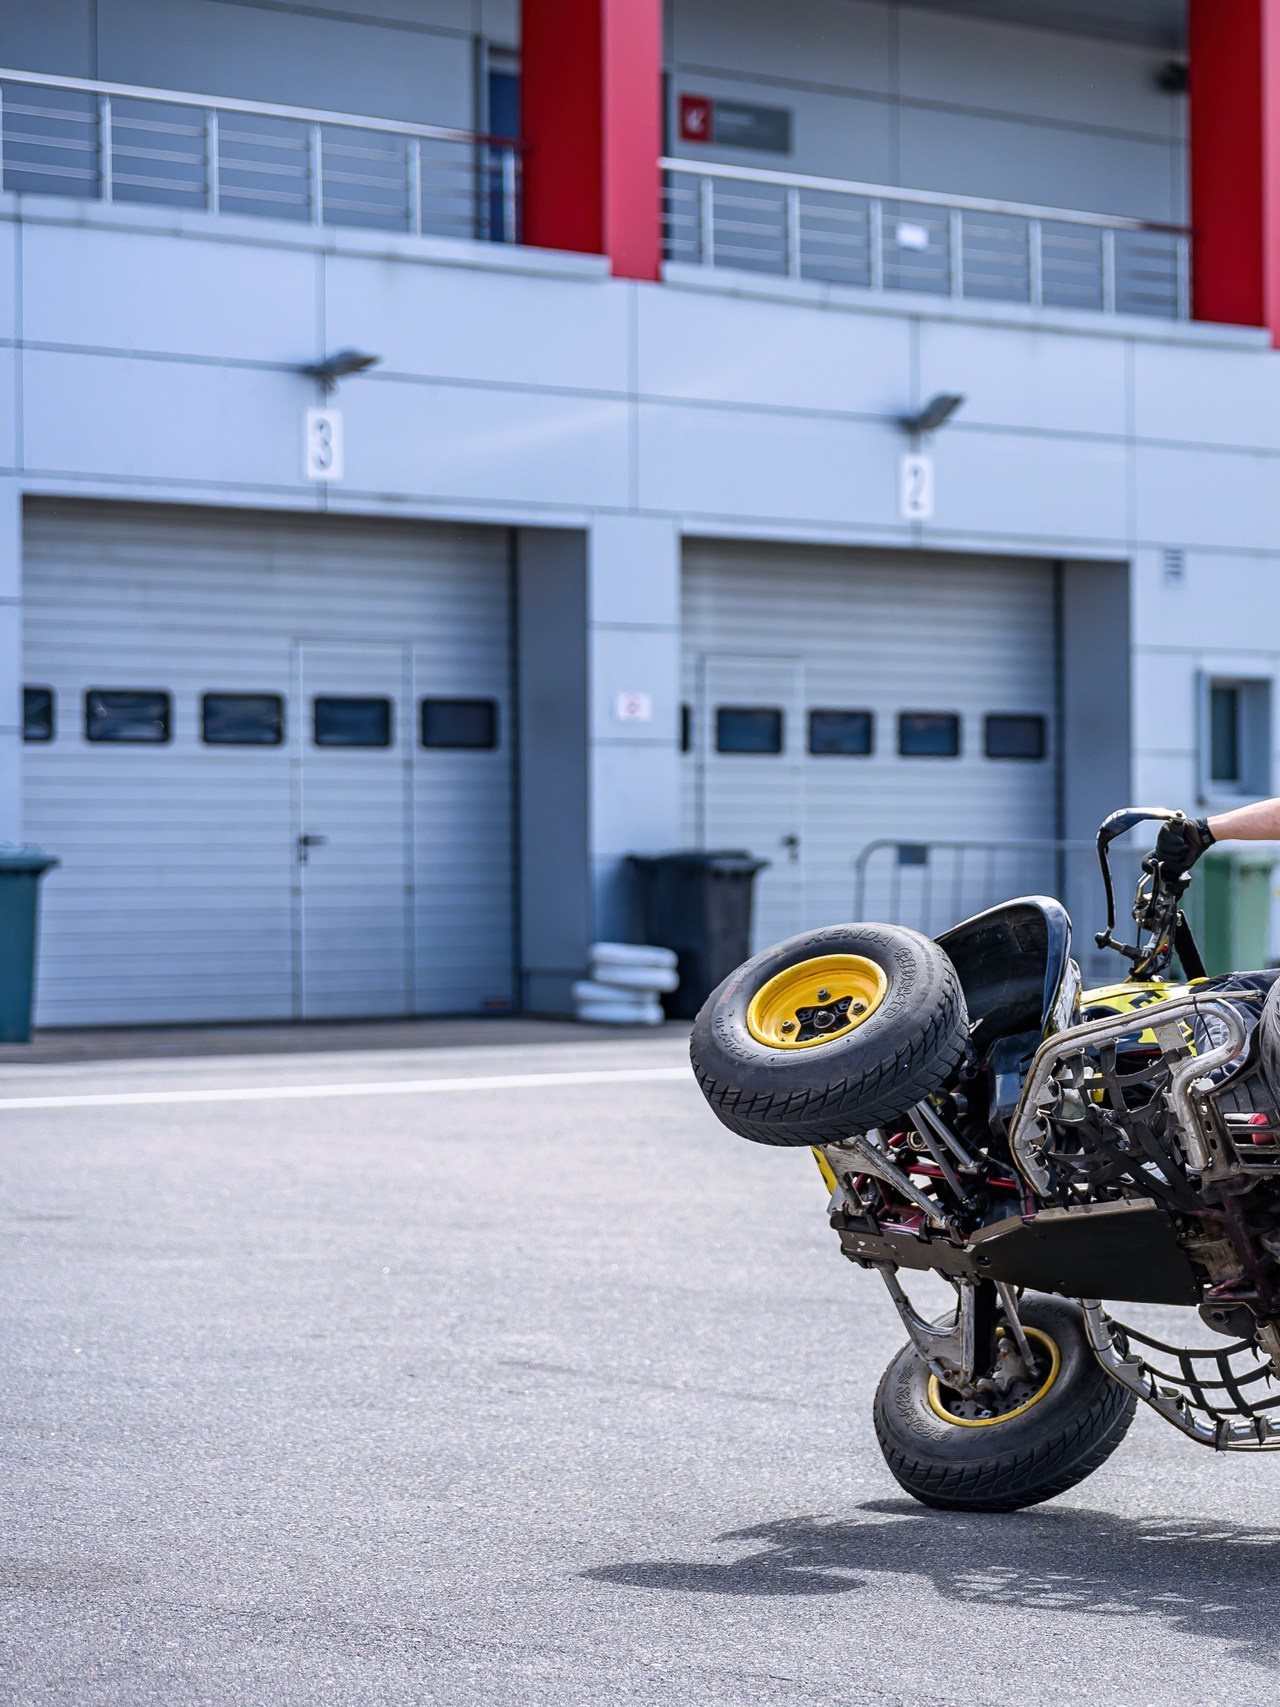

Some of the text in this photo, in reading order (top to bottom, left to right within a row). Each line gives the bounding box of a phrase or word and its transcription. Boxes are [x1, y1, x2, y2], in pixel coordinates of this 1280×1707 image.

[310, 418, 333, 470] 3
[908, 463, 926, 512] 2
[803, 928, 918, 1019] KENDA SPEEDRACER
